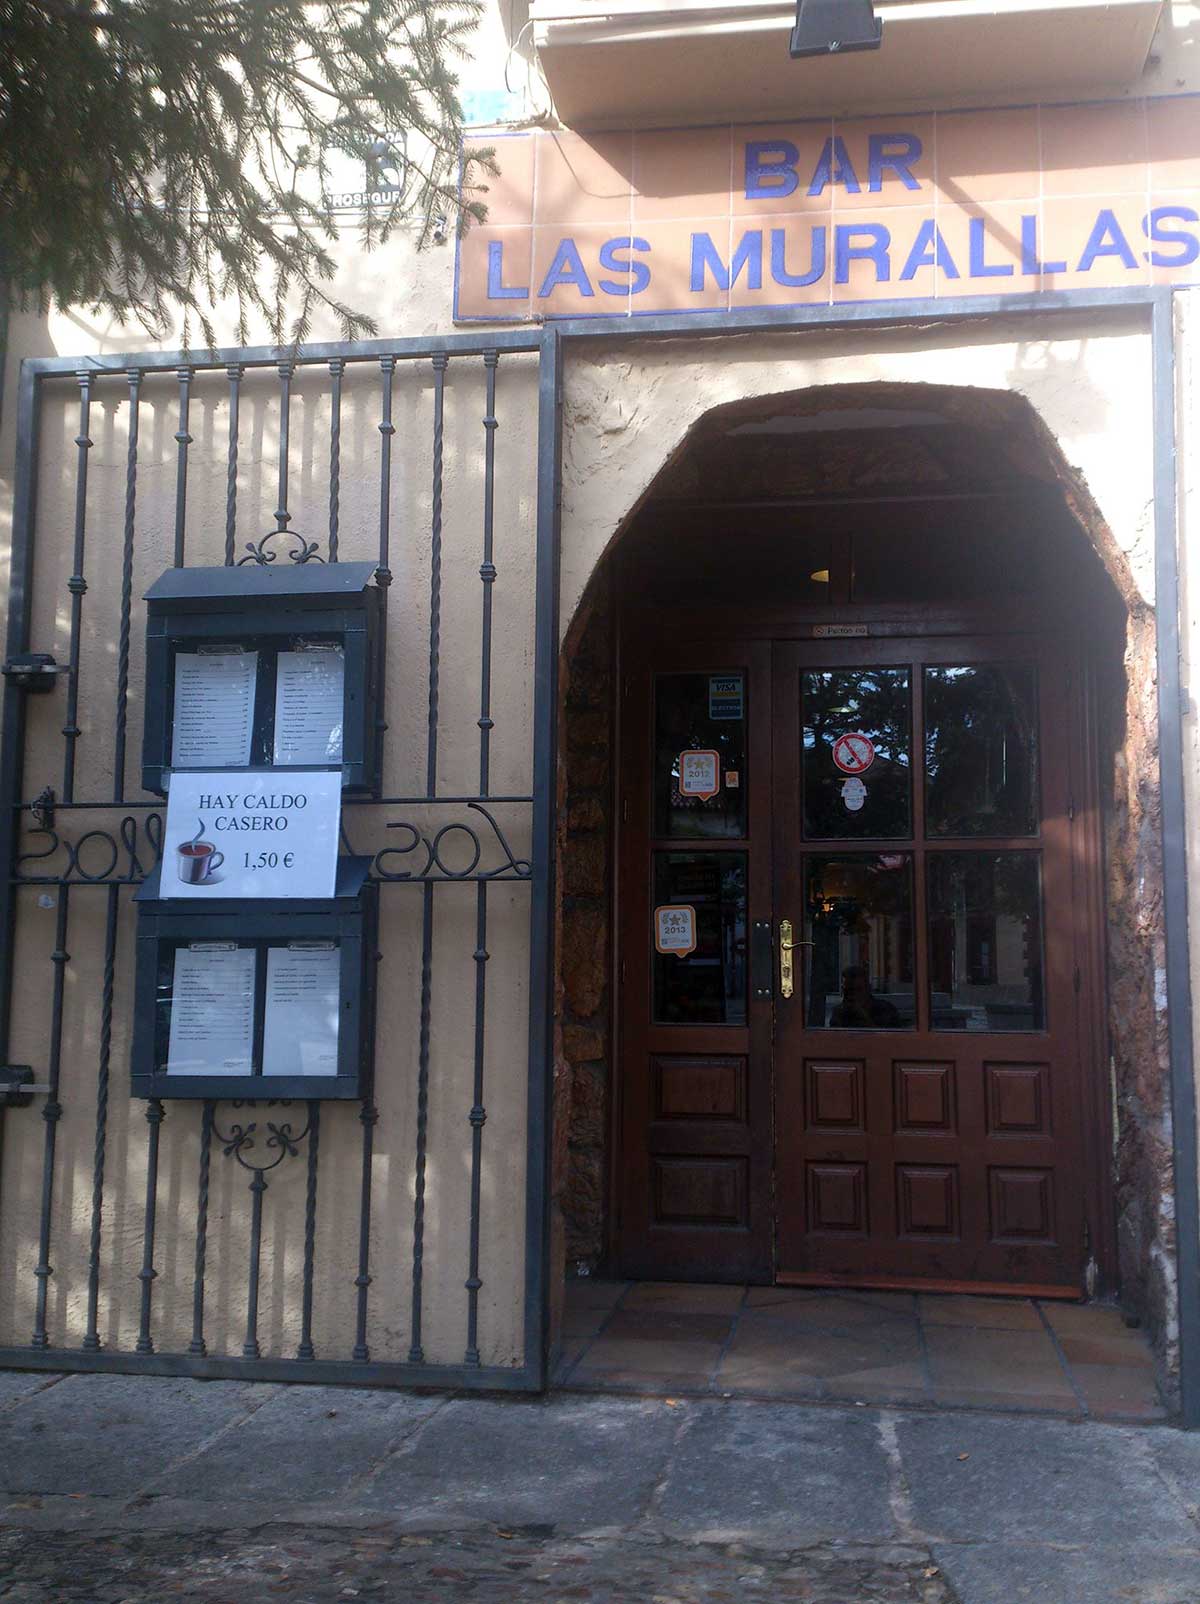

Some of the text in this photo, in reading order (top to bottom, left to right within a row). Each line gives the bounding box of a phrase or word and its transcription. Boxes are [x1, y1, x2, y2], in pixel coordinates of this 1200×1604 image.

[745, 132, 923, 200] BAR
[487, 205, 1200, 299] LAS MURALLAS
[199, 794, 307, 809] HAY CALDO
[215, 816, 288, 831] CASERO
[243, 852, 295, 871] 1,50 €
[664, 926, 686, 934] 2013
